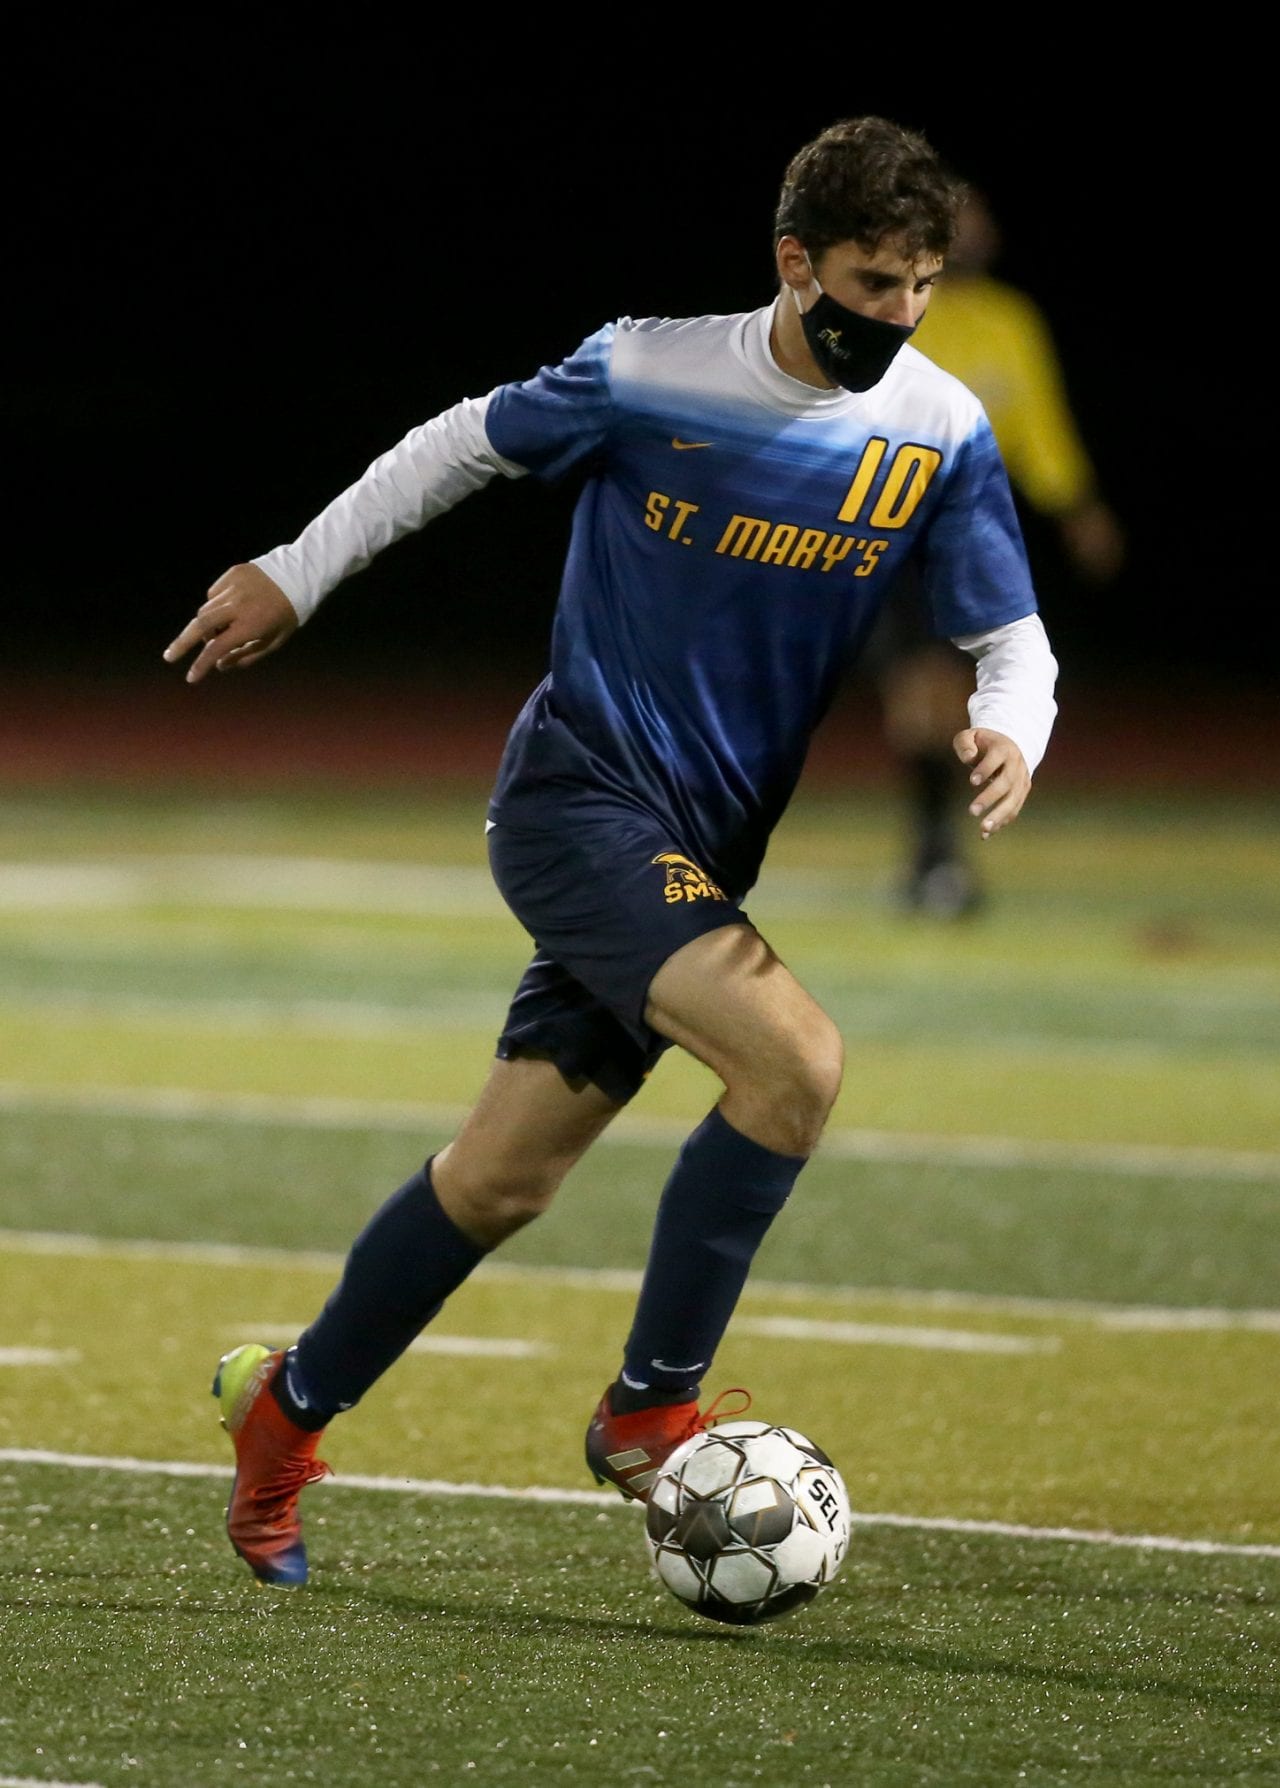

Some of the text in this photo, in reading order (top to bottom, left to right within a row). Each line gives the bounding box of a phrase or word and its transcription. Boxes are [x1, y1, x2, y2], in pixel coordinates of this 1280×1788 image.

[838, 436, 943, 529] 10
[644, 491, 889, 577] ST. MARY'S
